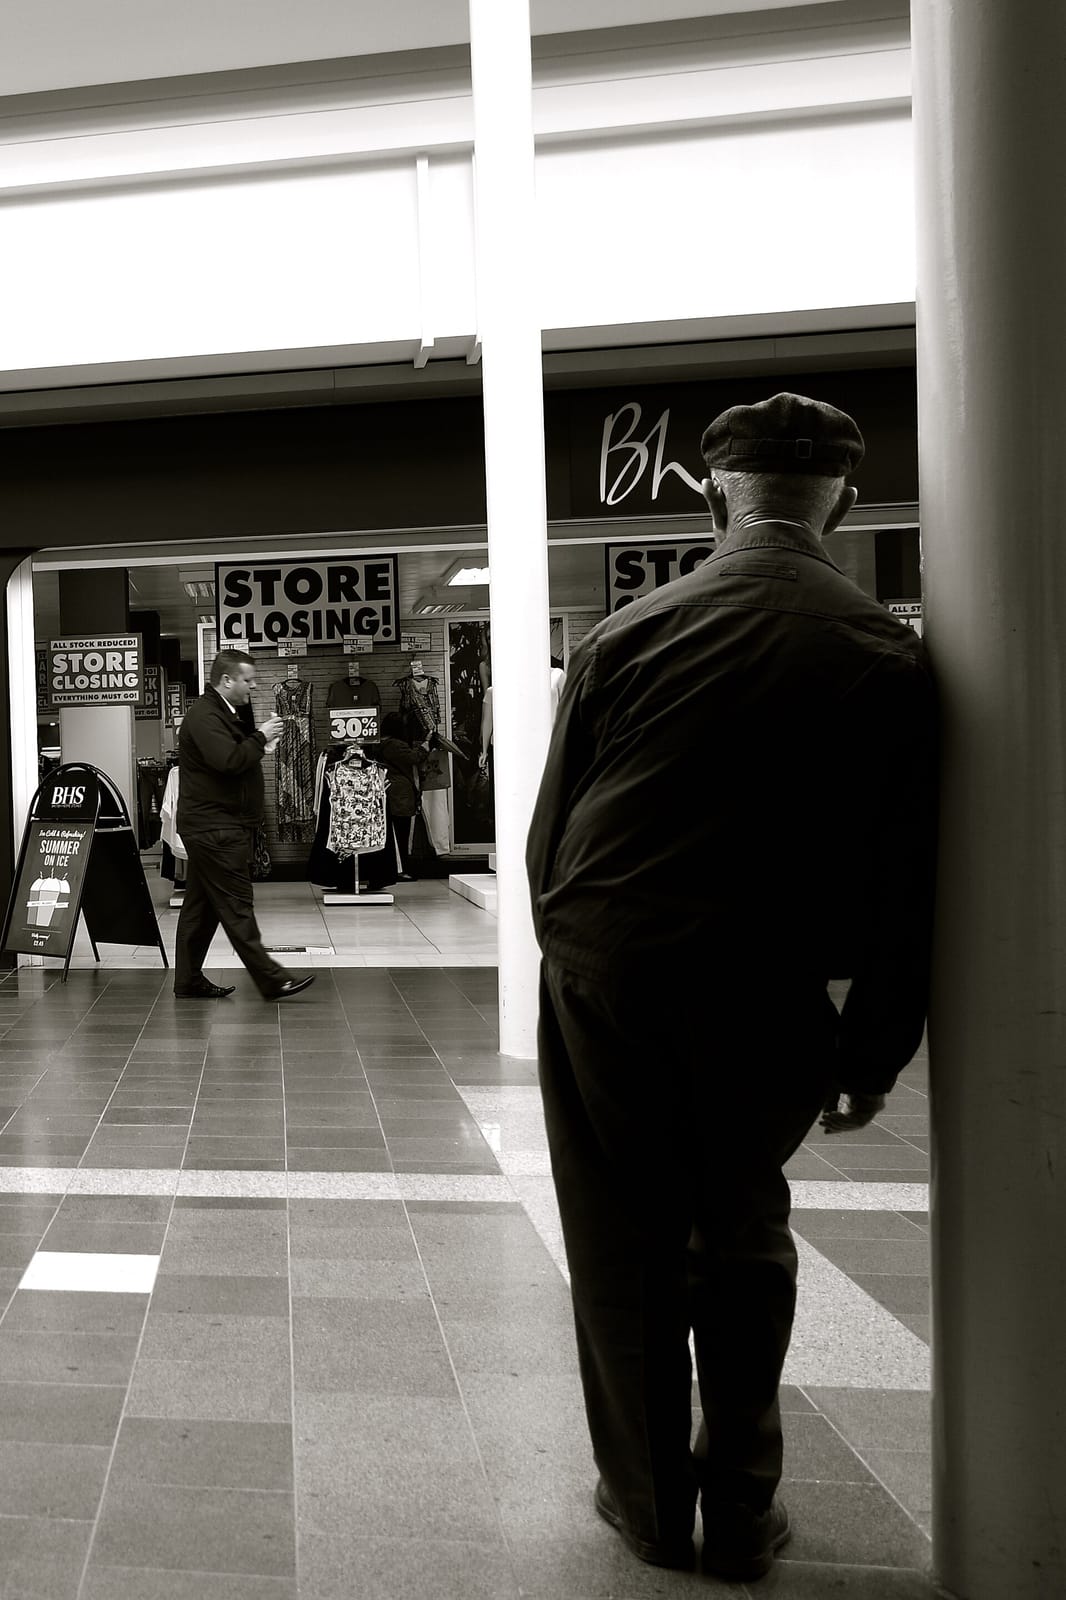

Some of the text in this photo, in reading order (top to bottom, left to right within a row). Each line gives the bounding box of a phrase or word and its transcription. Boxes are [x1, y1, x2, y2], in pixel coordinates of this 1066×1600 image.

[600, 402, 704, 506] Bh
[614, 546, 715, 589] STO
[223, 563, 391, 608] STORE
[223, 605, 392, 643] CLOSING!
[69, 641, 95, 649] STOCK
[97, 639, 136, 648] REDUCED!
[52, 651, 139, 674] STORE
[52, 673, 139, 690] CLOSING
[54, 694, 100, 702] EVERYTHING
[362, 728, 378, 737] OFF
[50, 786, 86, 805] BHS
[39, 839, 80, 855] SUMMER
[44, 855, 69, 867] ON ICE
